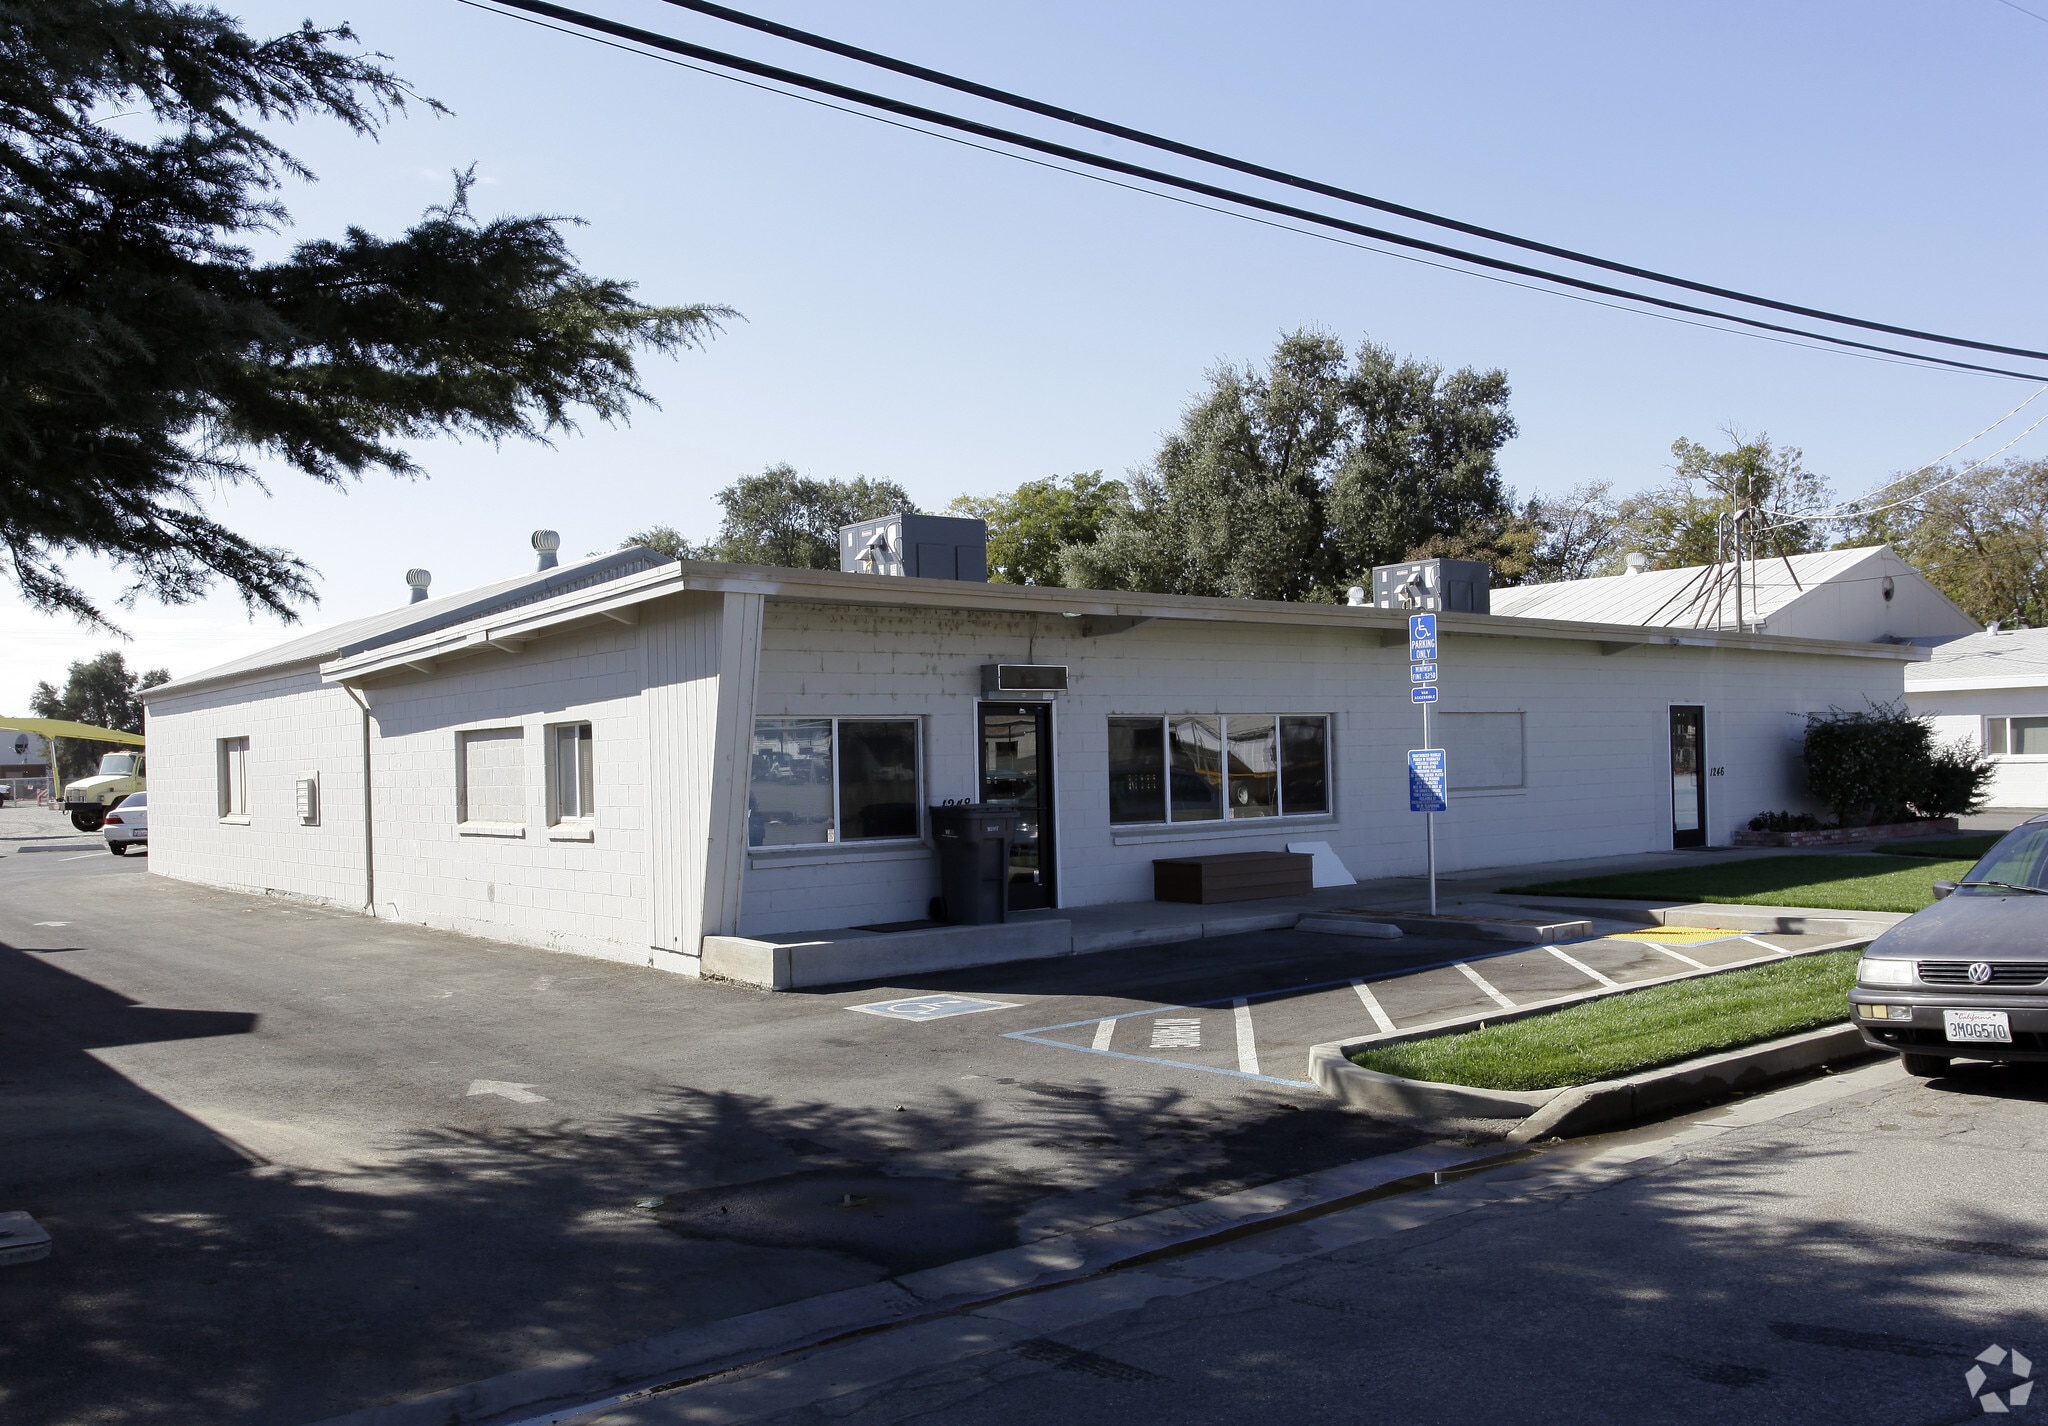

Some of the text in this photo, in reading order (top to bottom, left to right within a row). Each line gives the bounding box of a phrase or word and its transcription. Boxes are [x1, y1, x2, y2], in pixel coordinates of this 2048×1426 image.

[1411, 639, 1435, 649] PARKING
[1416, 649, 1431, 659] ONLY
[1710, 766, 1725, 777] 1246
[1958, 1013, 1993, 1021] California
